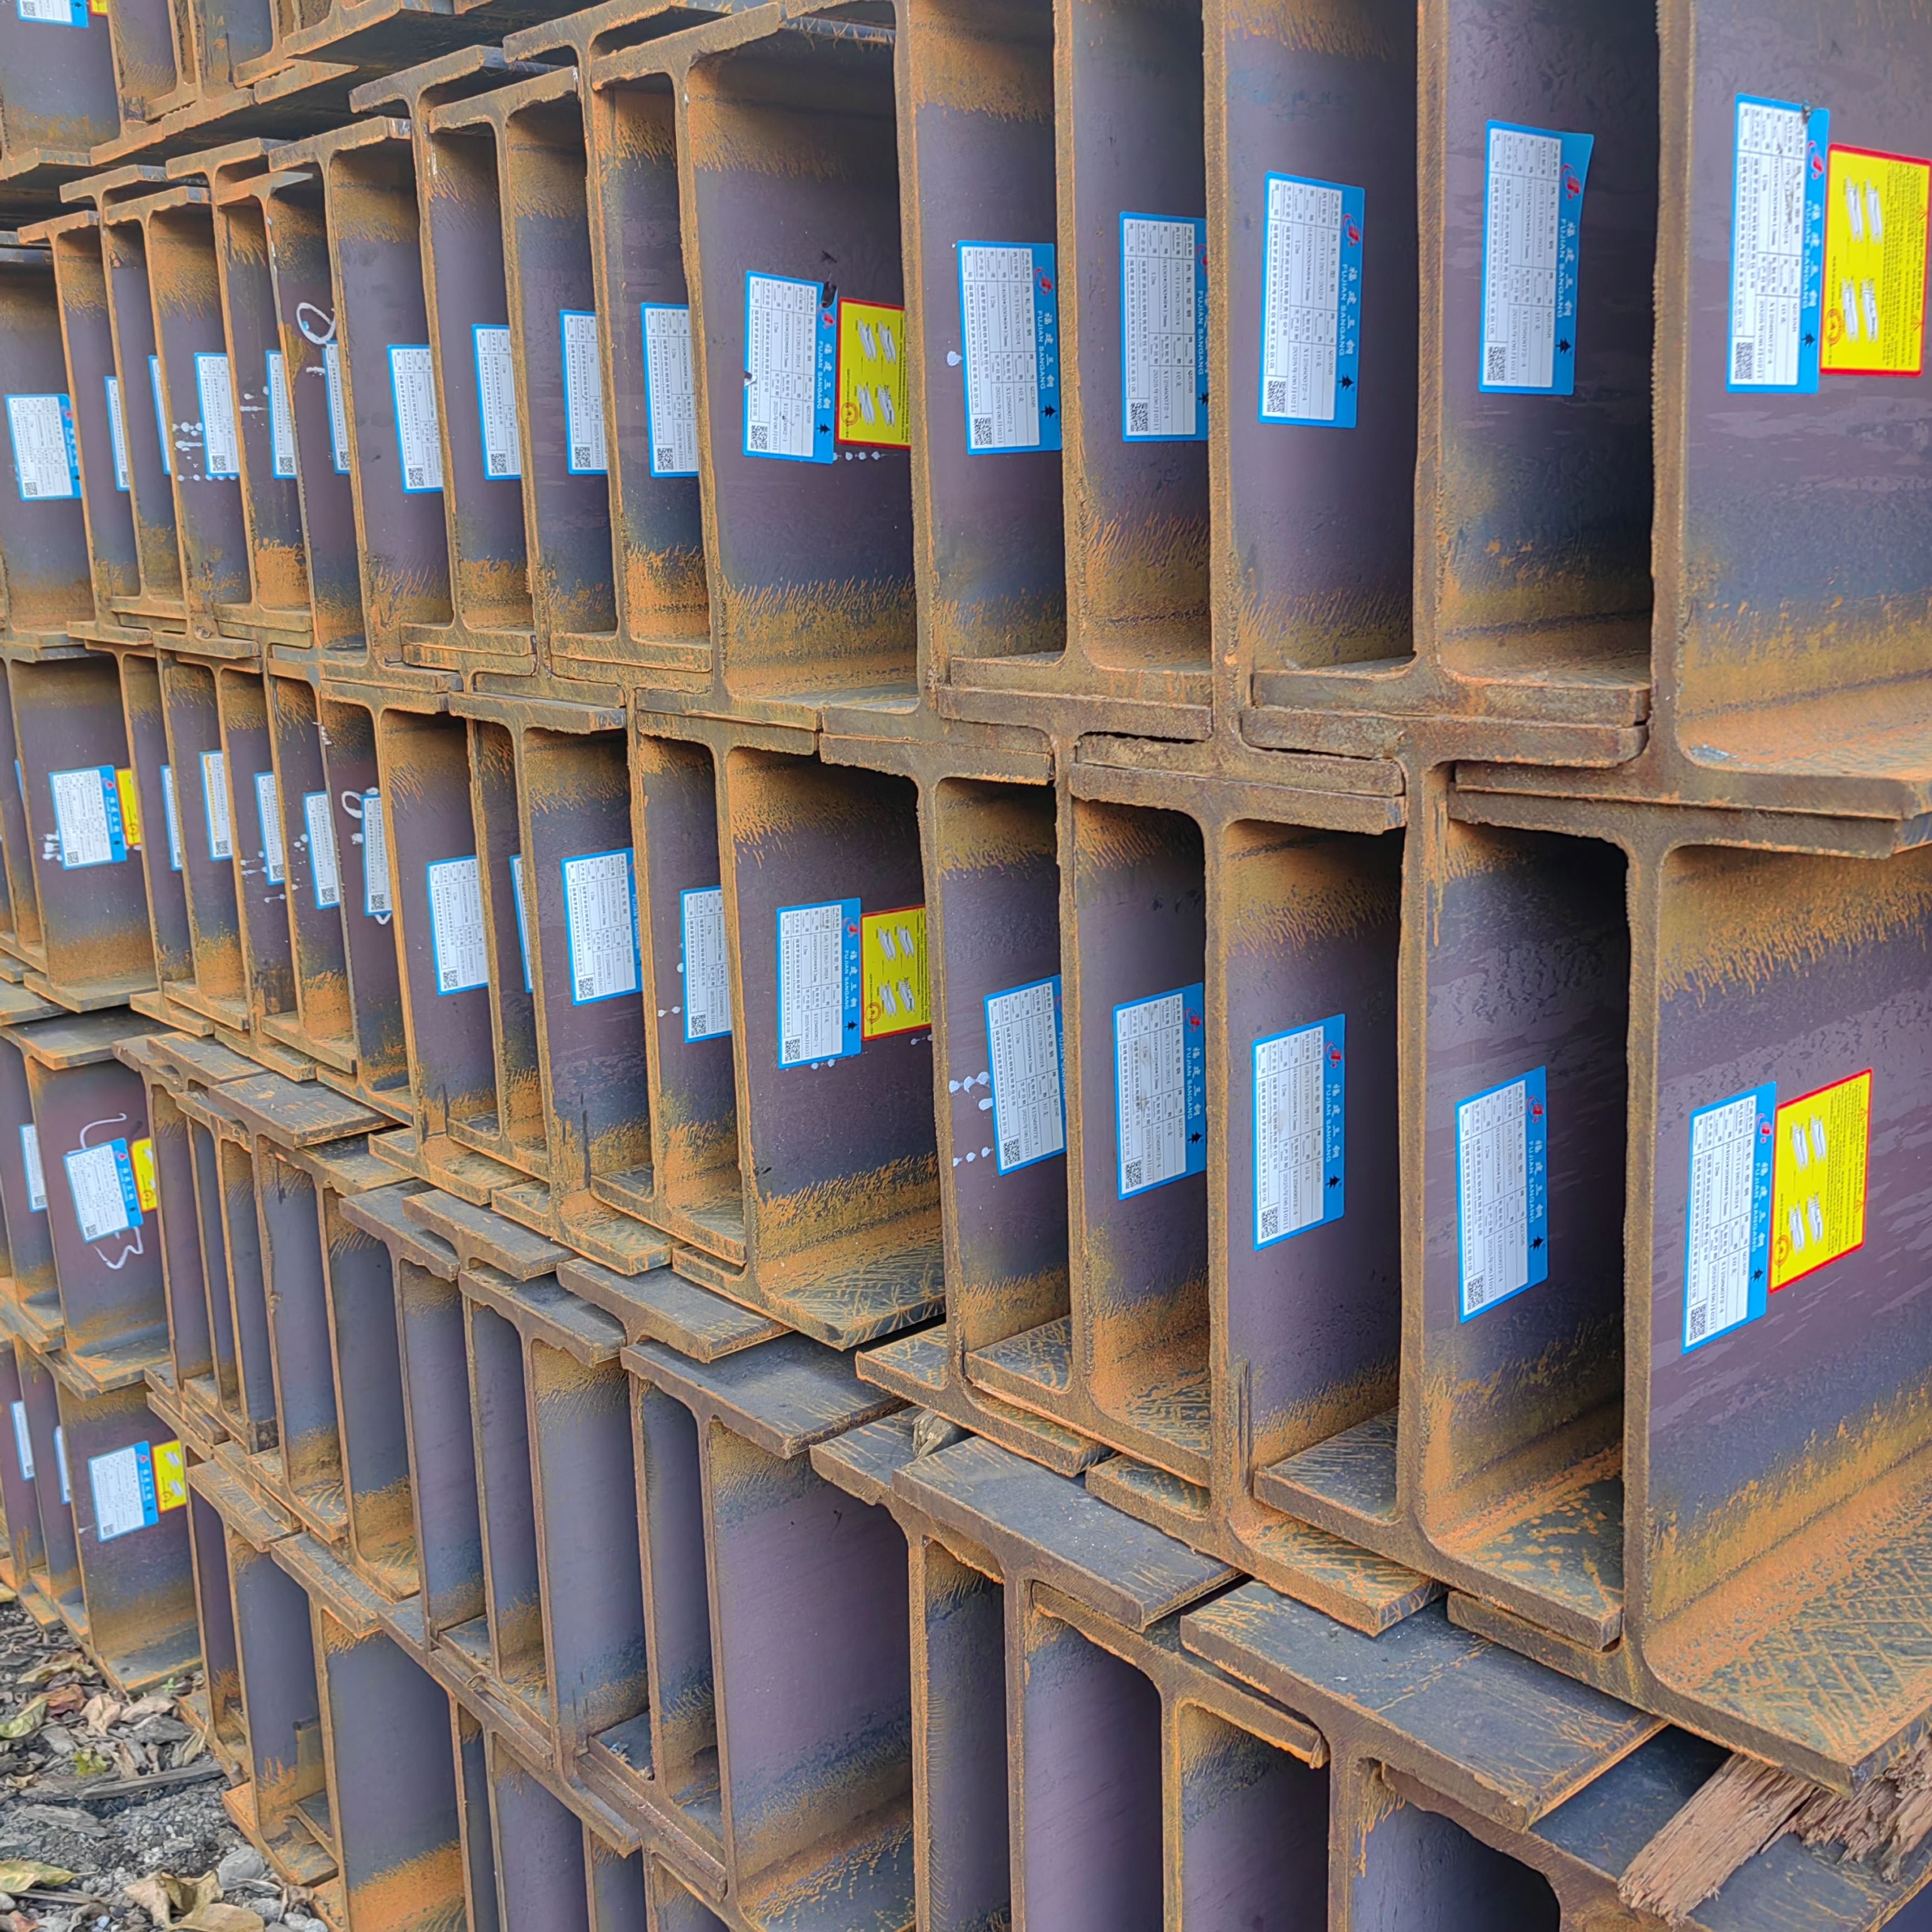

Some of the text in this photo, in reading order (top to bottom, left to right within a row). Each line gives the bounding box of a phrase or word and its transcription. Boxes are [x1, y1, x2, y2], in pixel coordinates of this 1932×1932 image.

[1558, 218, 1567, 258] FUJIAN
[1338, 263, 1348, 356] FUJIAN SANGANG
[1345, 266, 1358, 355] 福建三钢
[822, 342, 833, 409] 福建三钢
[1038, 345, 1046, 389] SANGANG
[1043, 312, 1055, 387] 福建三钢
[848, 950, 858, 1008] 福建三钢
[1191, 1045, 1202, 1116] 福建三钢
[1331, 1082, 1341, 1159] 福建三钢
